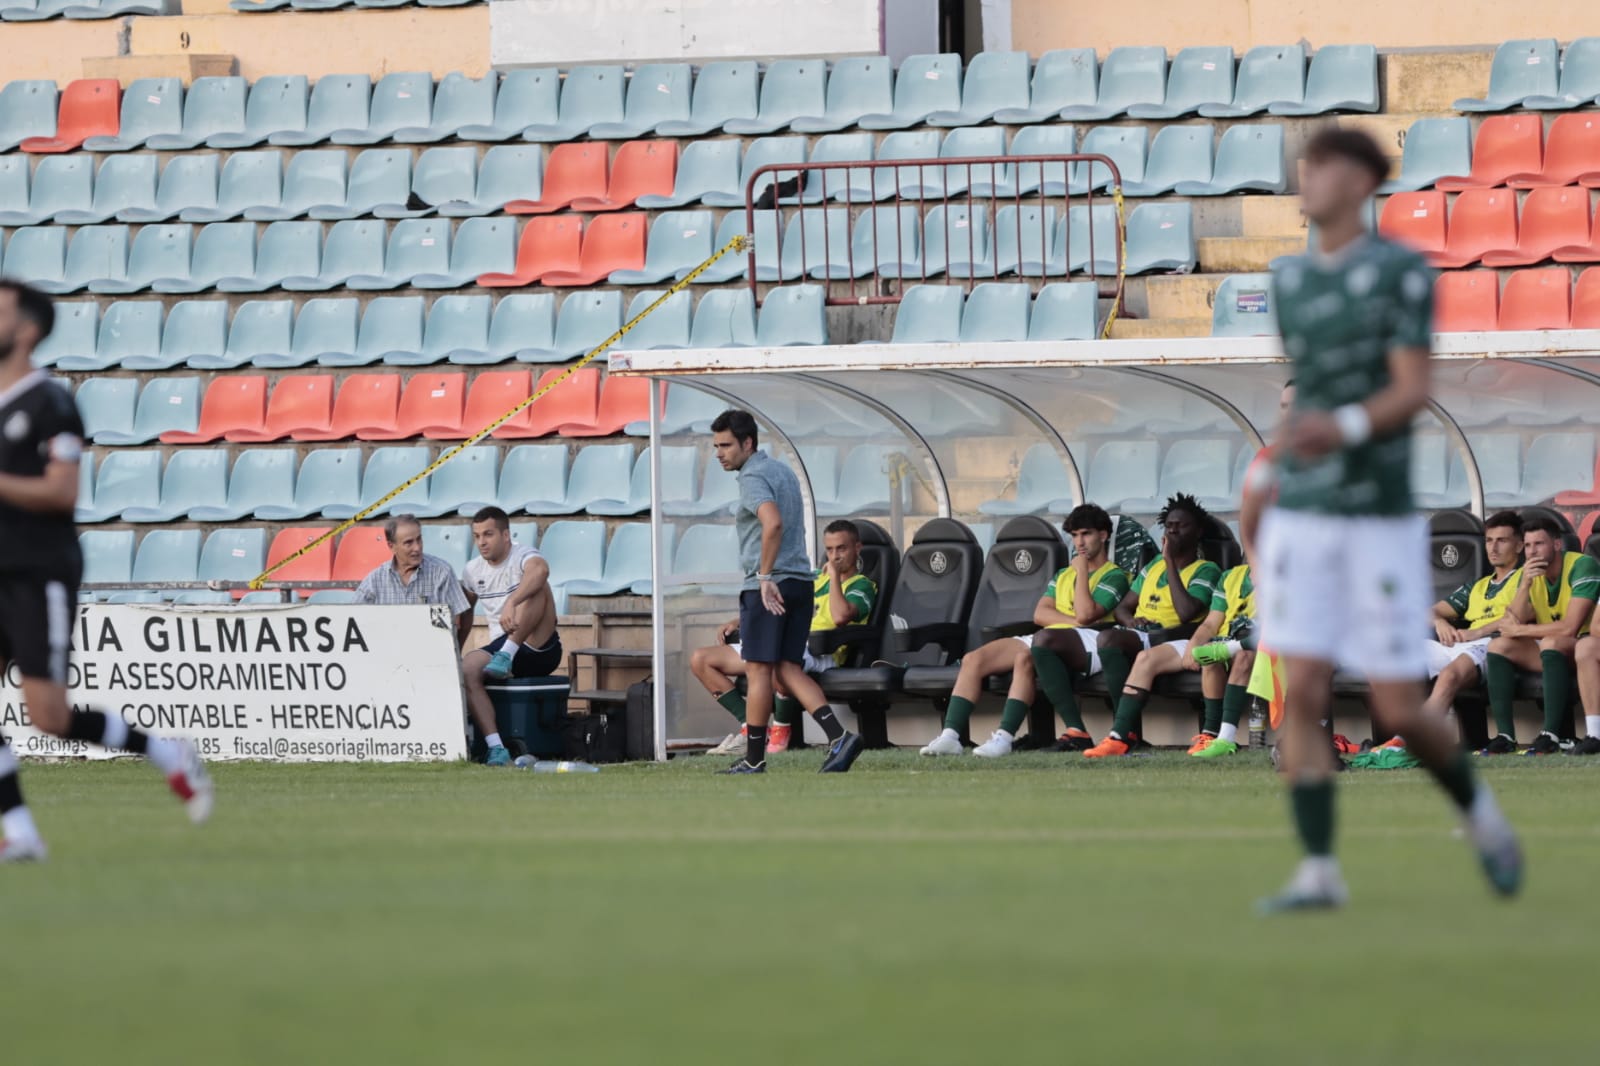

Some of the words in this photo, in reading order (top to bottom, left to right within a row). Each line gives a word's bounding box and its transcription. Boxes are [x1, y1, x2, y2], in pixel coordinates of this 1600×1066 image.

[180, 31, 190, 49] 9
[143, 615, 369, 653] GILMARSA
[67, 662, 99, 690] DE
[108, 661, 347, 691] ASESORAMIENTO
[121, 703, 248, 729] CONTABLE
[270, 703, 411, 730] HERENCIAS
[26, 735, 88, 753] Oficinas
[233, 736, 447, 760] fiscal@asesoriagilmarsa.es
